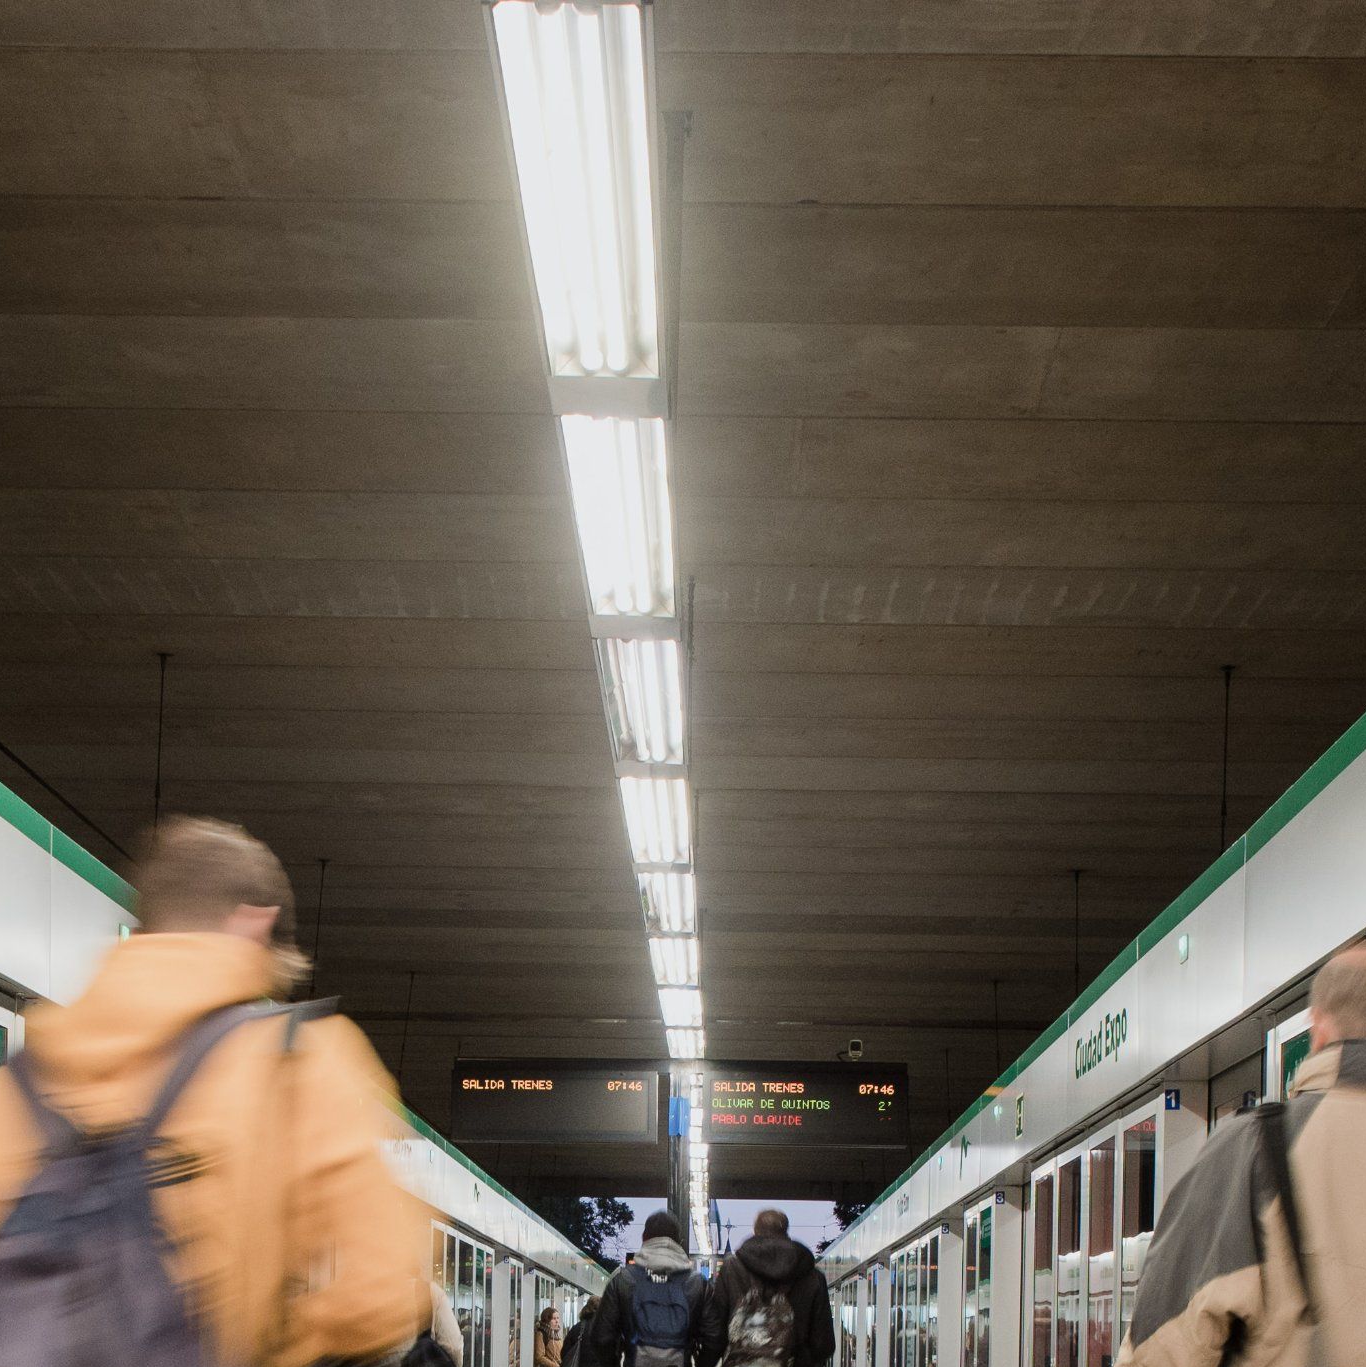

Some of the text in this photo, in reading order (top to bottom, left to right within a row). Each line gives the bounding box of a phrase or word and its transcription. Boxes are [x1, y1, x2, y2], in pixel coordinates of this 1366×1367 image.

[1075, 1007, 1127, 1079] Ciudad Expo
[462, 1079, 643, 1091] SALIDA TRENES 07:46
[713, 1082, 895, 1095] SALIDA TRENES 07:46
[711, 1098, 754, 1109] OLIVAR
[760, 1099, 775, 1109] DE
[781, 1099, 831, 1110] QUINTOS
[1166, 1091, 1176, 1108] 1
[711, 1114, 803, 1126] PABLO OLAVIDE
[996, 1192, 1004, 1203] 3
